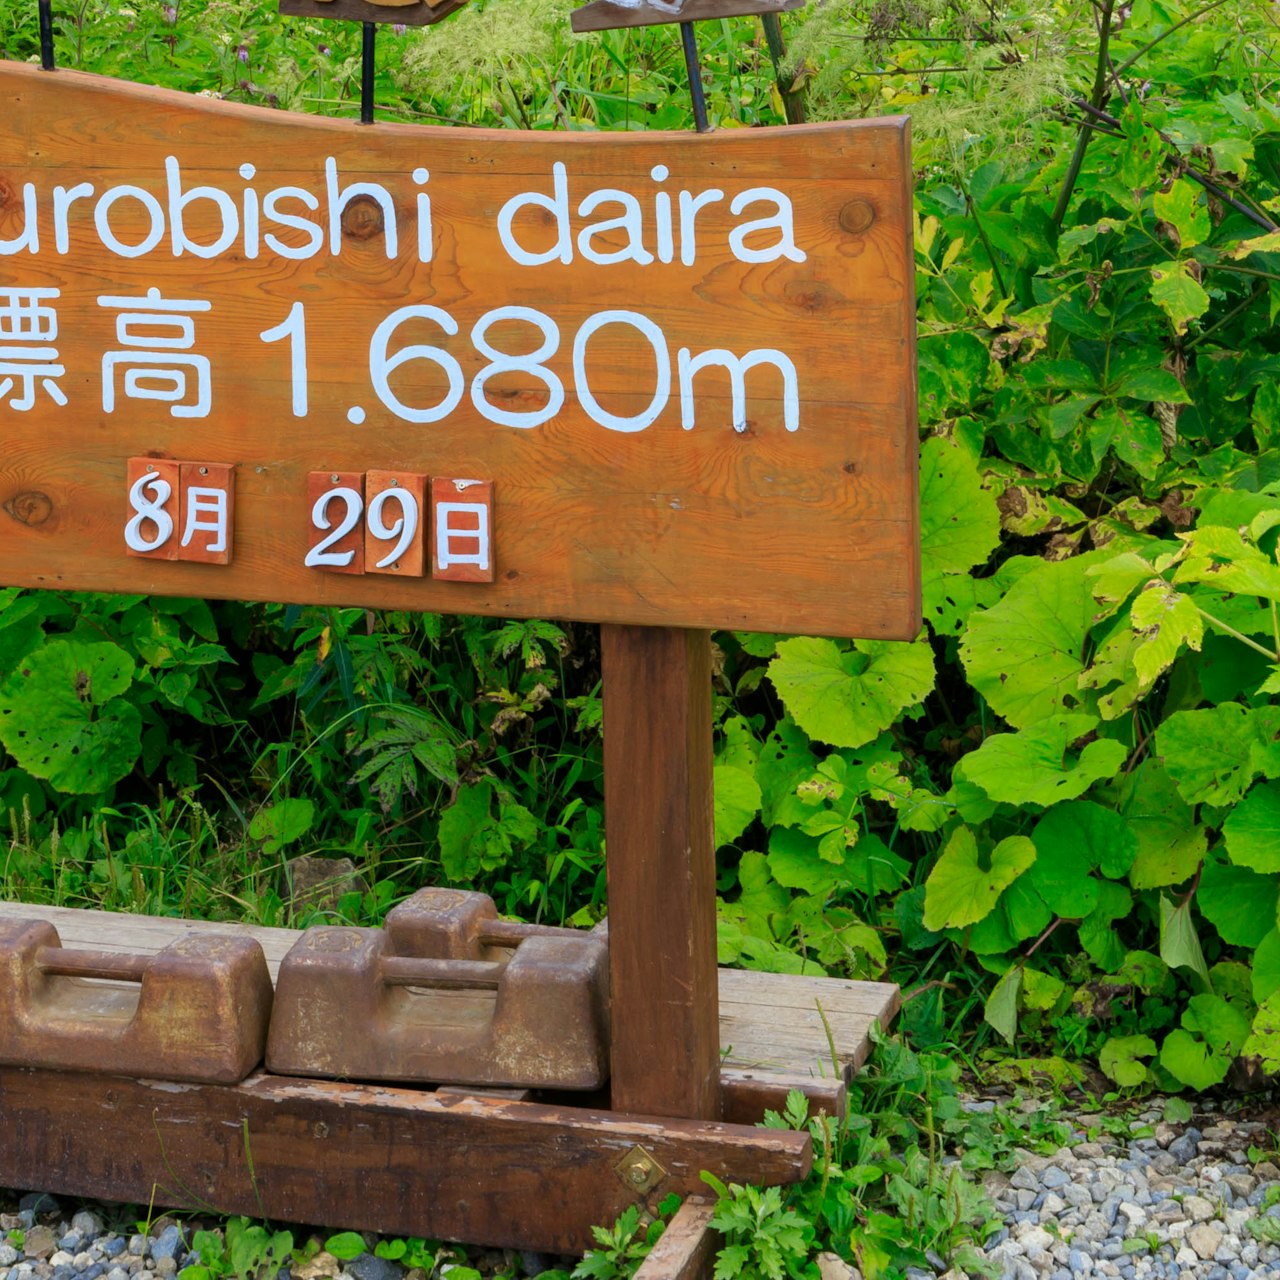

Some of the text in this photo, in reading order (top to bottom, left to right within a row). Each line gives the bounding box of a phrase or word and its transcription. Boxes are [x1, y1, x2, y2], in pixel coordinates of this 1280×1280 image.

[497, 162, 807, 266] daira
[125, 472, 488, 570] 8月 29日
